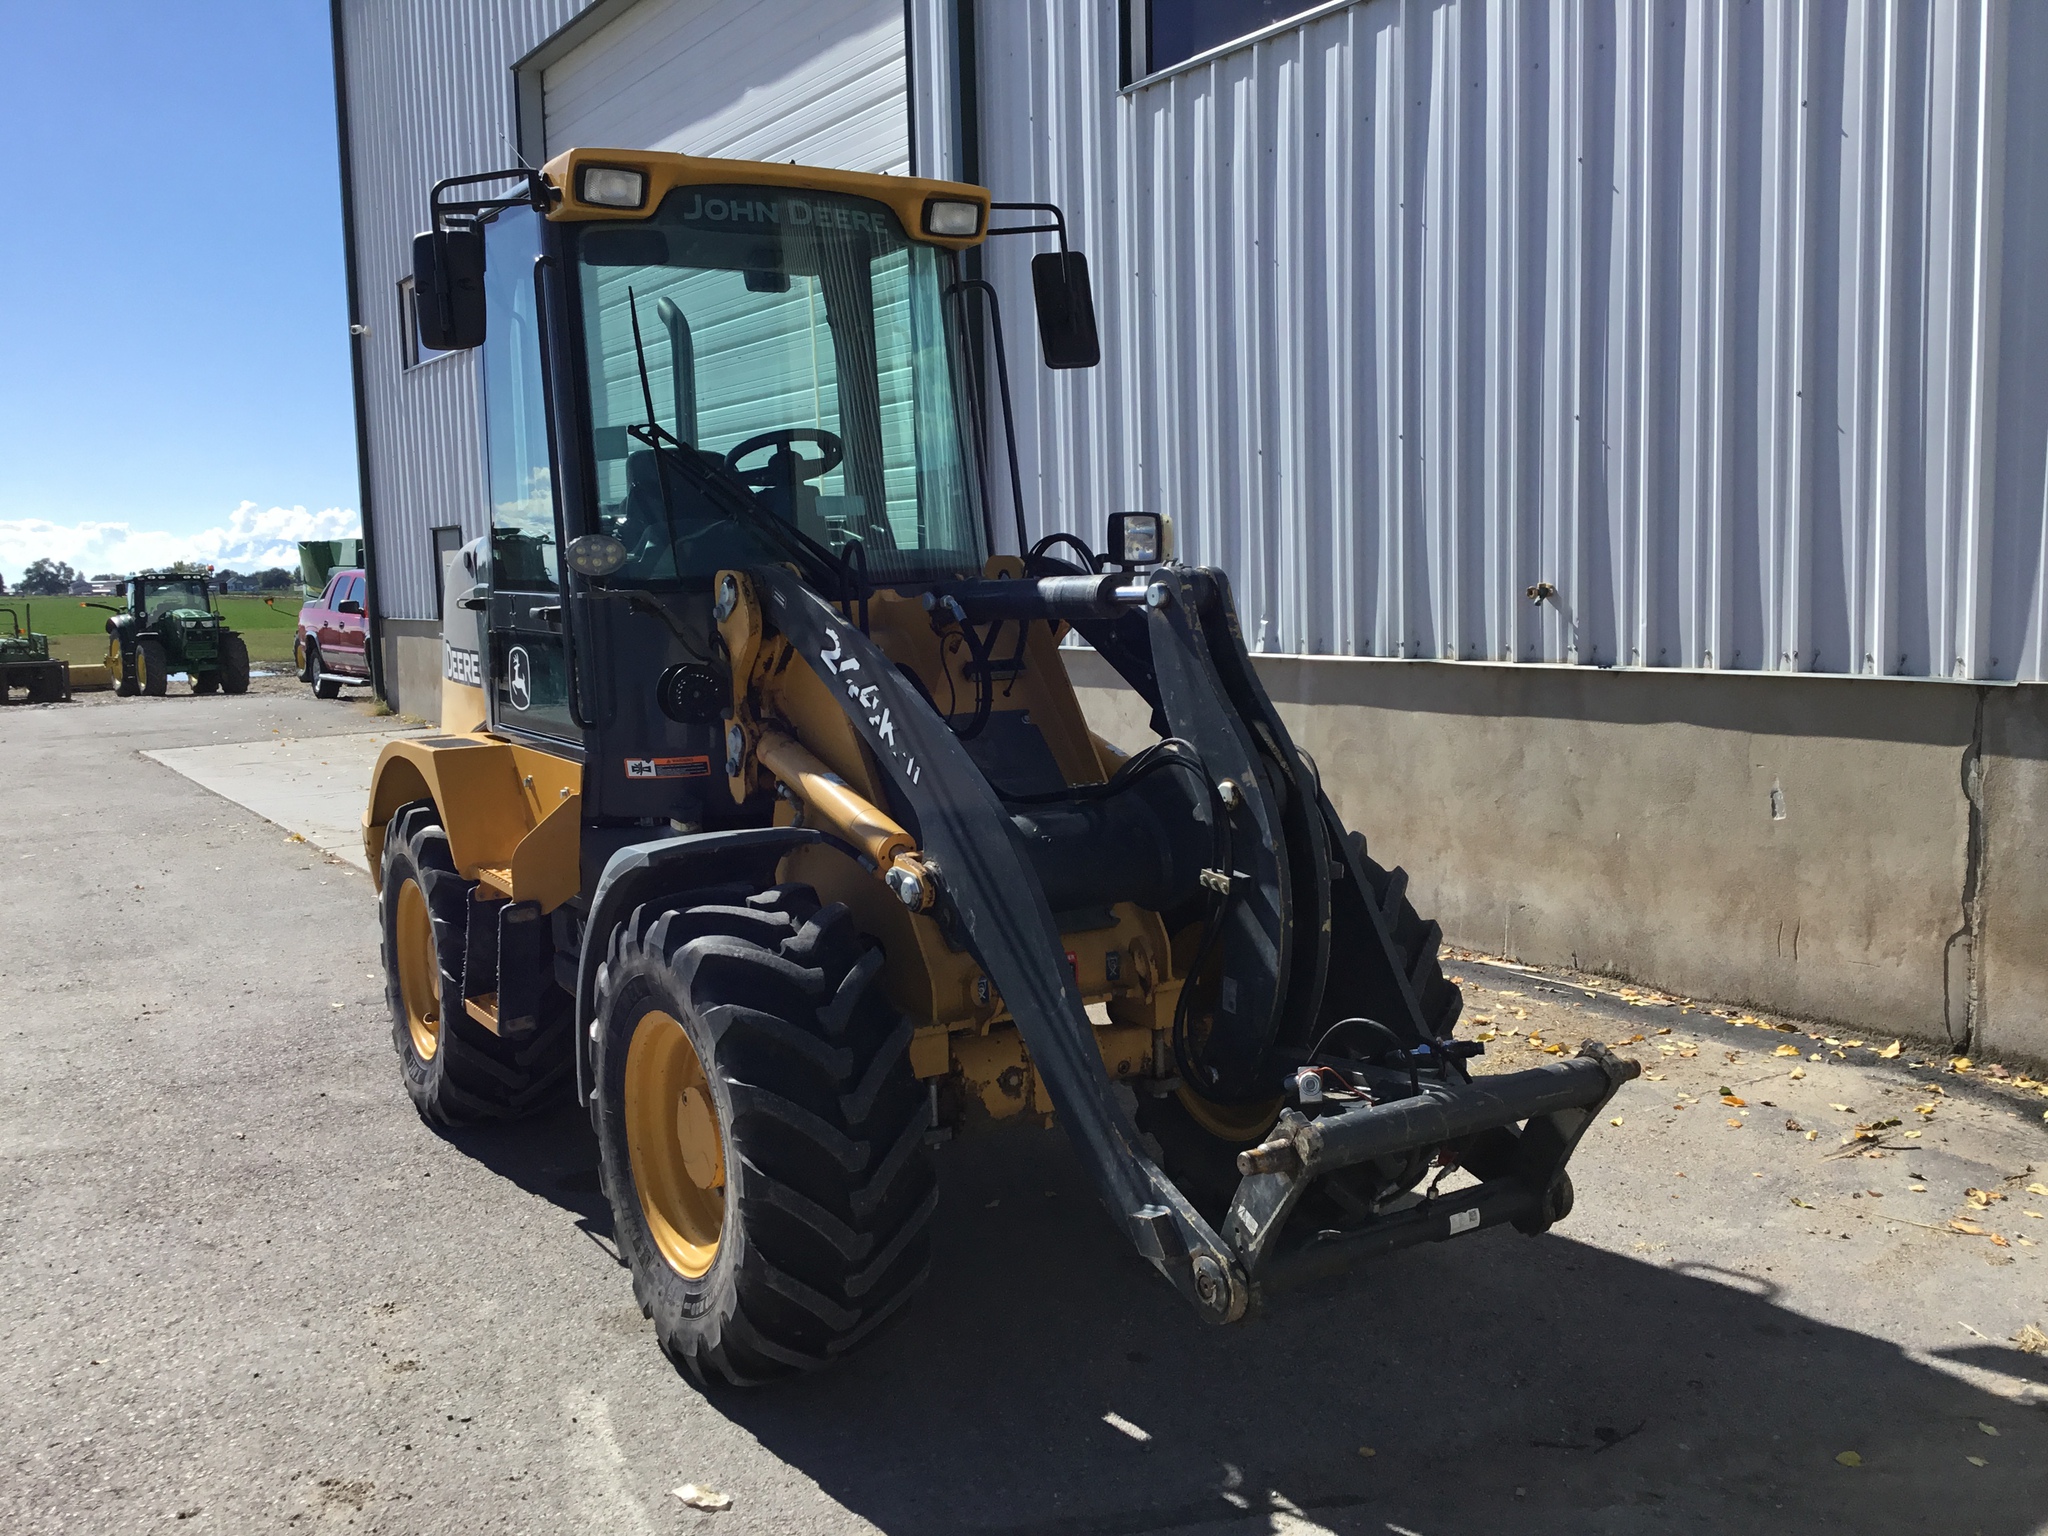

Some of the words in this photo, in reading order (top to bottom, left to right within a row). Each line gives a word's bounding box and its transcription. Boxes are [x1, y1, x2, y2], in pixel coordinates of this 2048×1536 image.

[684, 194, 779, 224] JOHN
[790, 201, 887, 234] DEERE
[446, 640, 481, 685] DEERE
